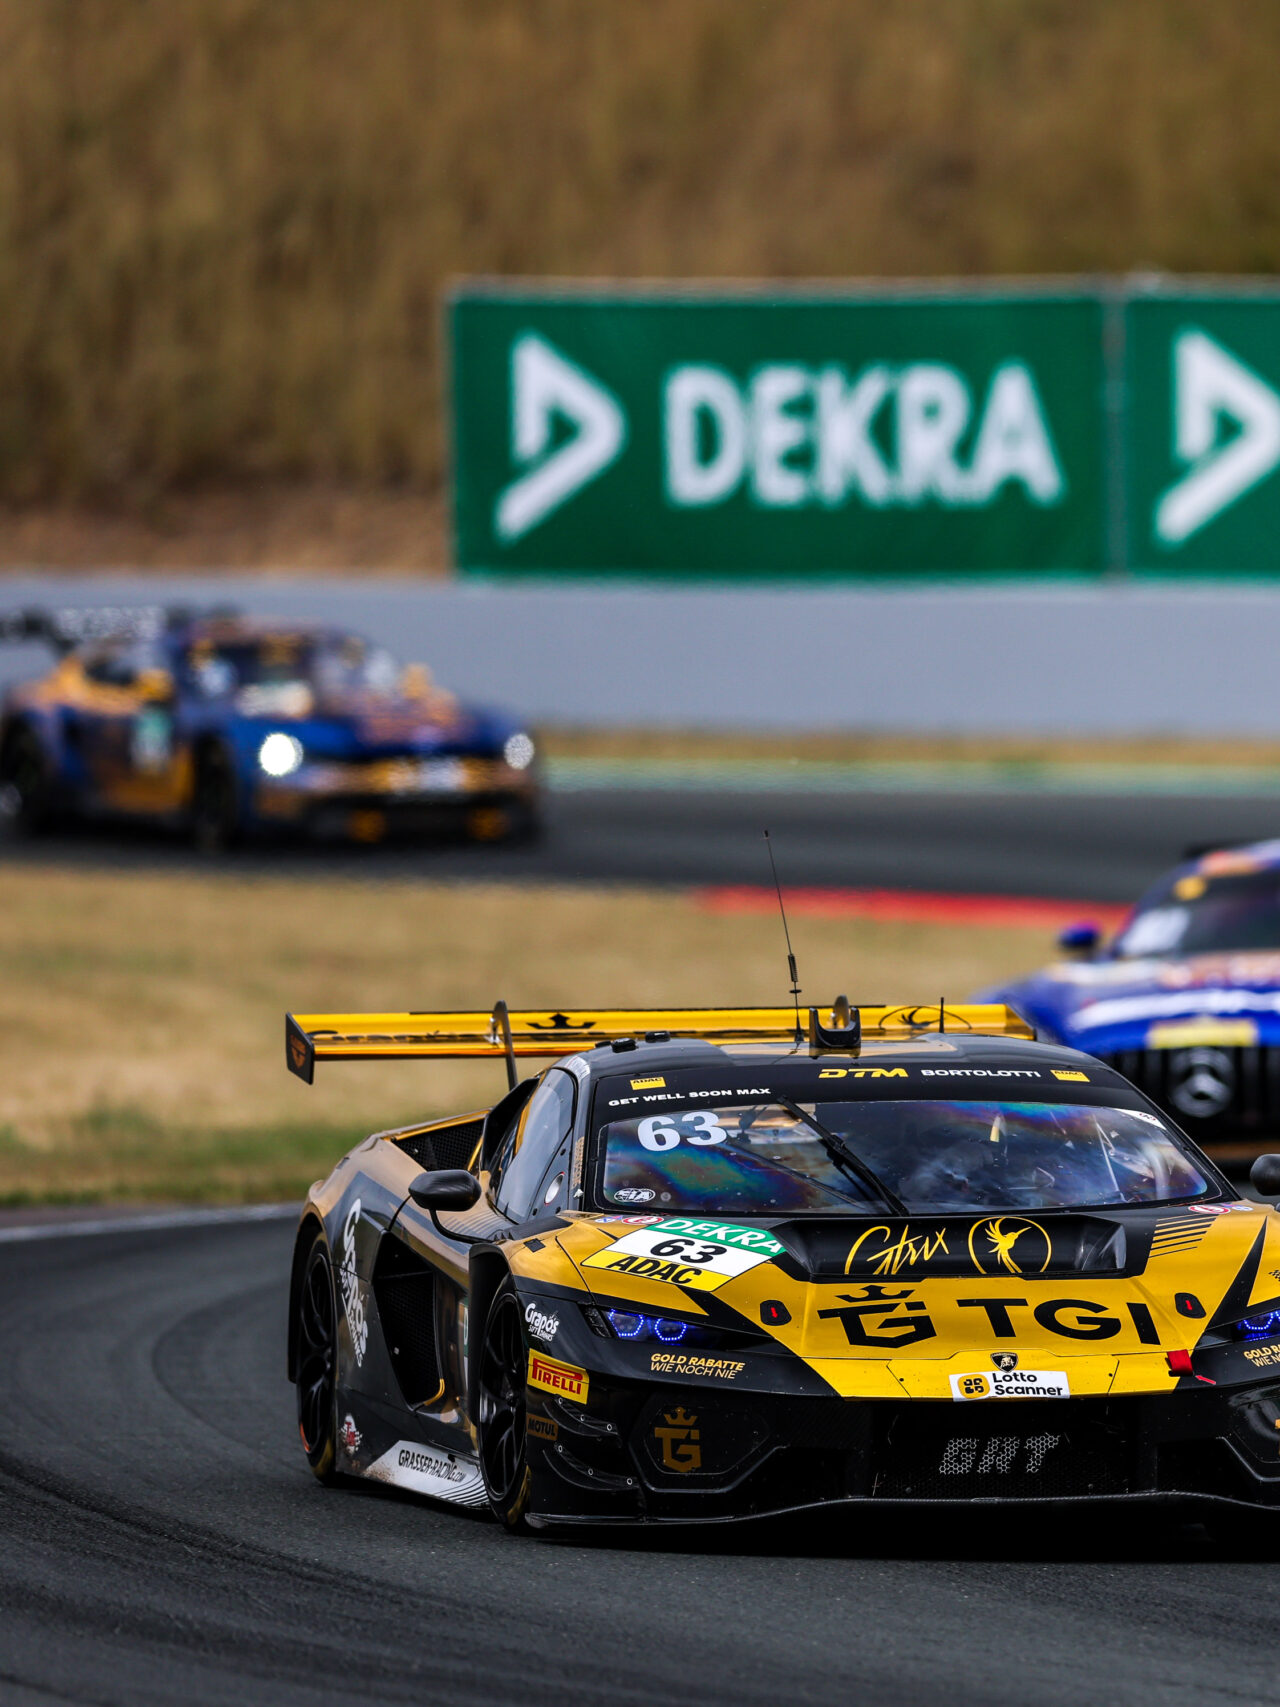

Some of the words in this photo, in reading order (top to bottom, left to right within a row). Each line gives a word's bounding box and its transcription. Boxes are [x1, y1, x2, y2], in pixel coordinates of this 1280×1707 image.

[664, 358, 1066, 507] DEKRA
[632, 1076, 664, 1085] ADAC
[818, 1067, 909, 1079] DTM
[920, 1069, 1042, 1078] BORTOLOTTI
[608, 1096, 640, 1107] GET
[643, 1092, 685, 1103] WELL
[688, 1088, 733, 1099] SOON
[736, 1087, 772, 1096] MAX
[637, 1111, 728, 1152] 63
[655, 1218, 785, 1255] DEKRA
[649, 1238, 728, 1264] 63
[607, 1255, 703, 1285] ADAC
[525, 1303, 560, 1337] Grapos
[956, 1298, 1161, 1346] TGI
[650, 1353, 687, 1364] GOLD
[688, 1356, 746, 1371] RABATTE
[1243, 1346, 1272, 1360] GOLD
[1251, 1355, 1273, 1367] WIE
[531, 1357, 584, 1395] PIRELLI
[650, 1361, 675, 1373] WIE
[674, 1364, 715, 1377] NOCH
[714, 1368, 738, 1379] NIE
[993, 1372, 1037, 1383] Lotto
[994, 1384, 1063, 1396] Scanner
[527, 1417, 556, 1437] MOTUL
